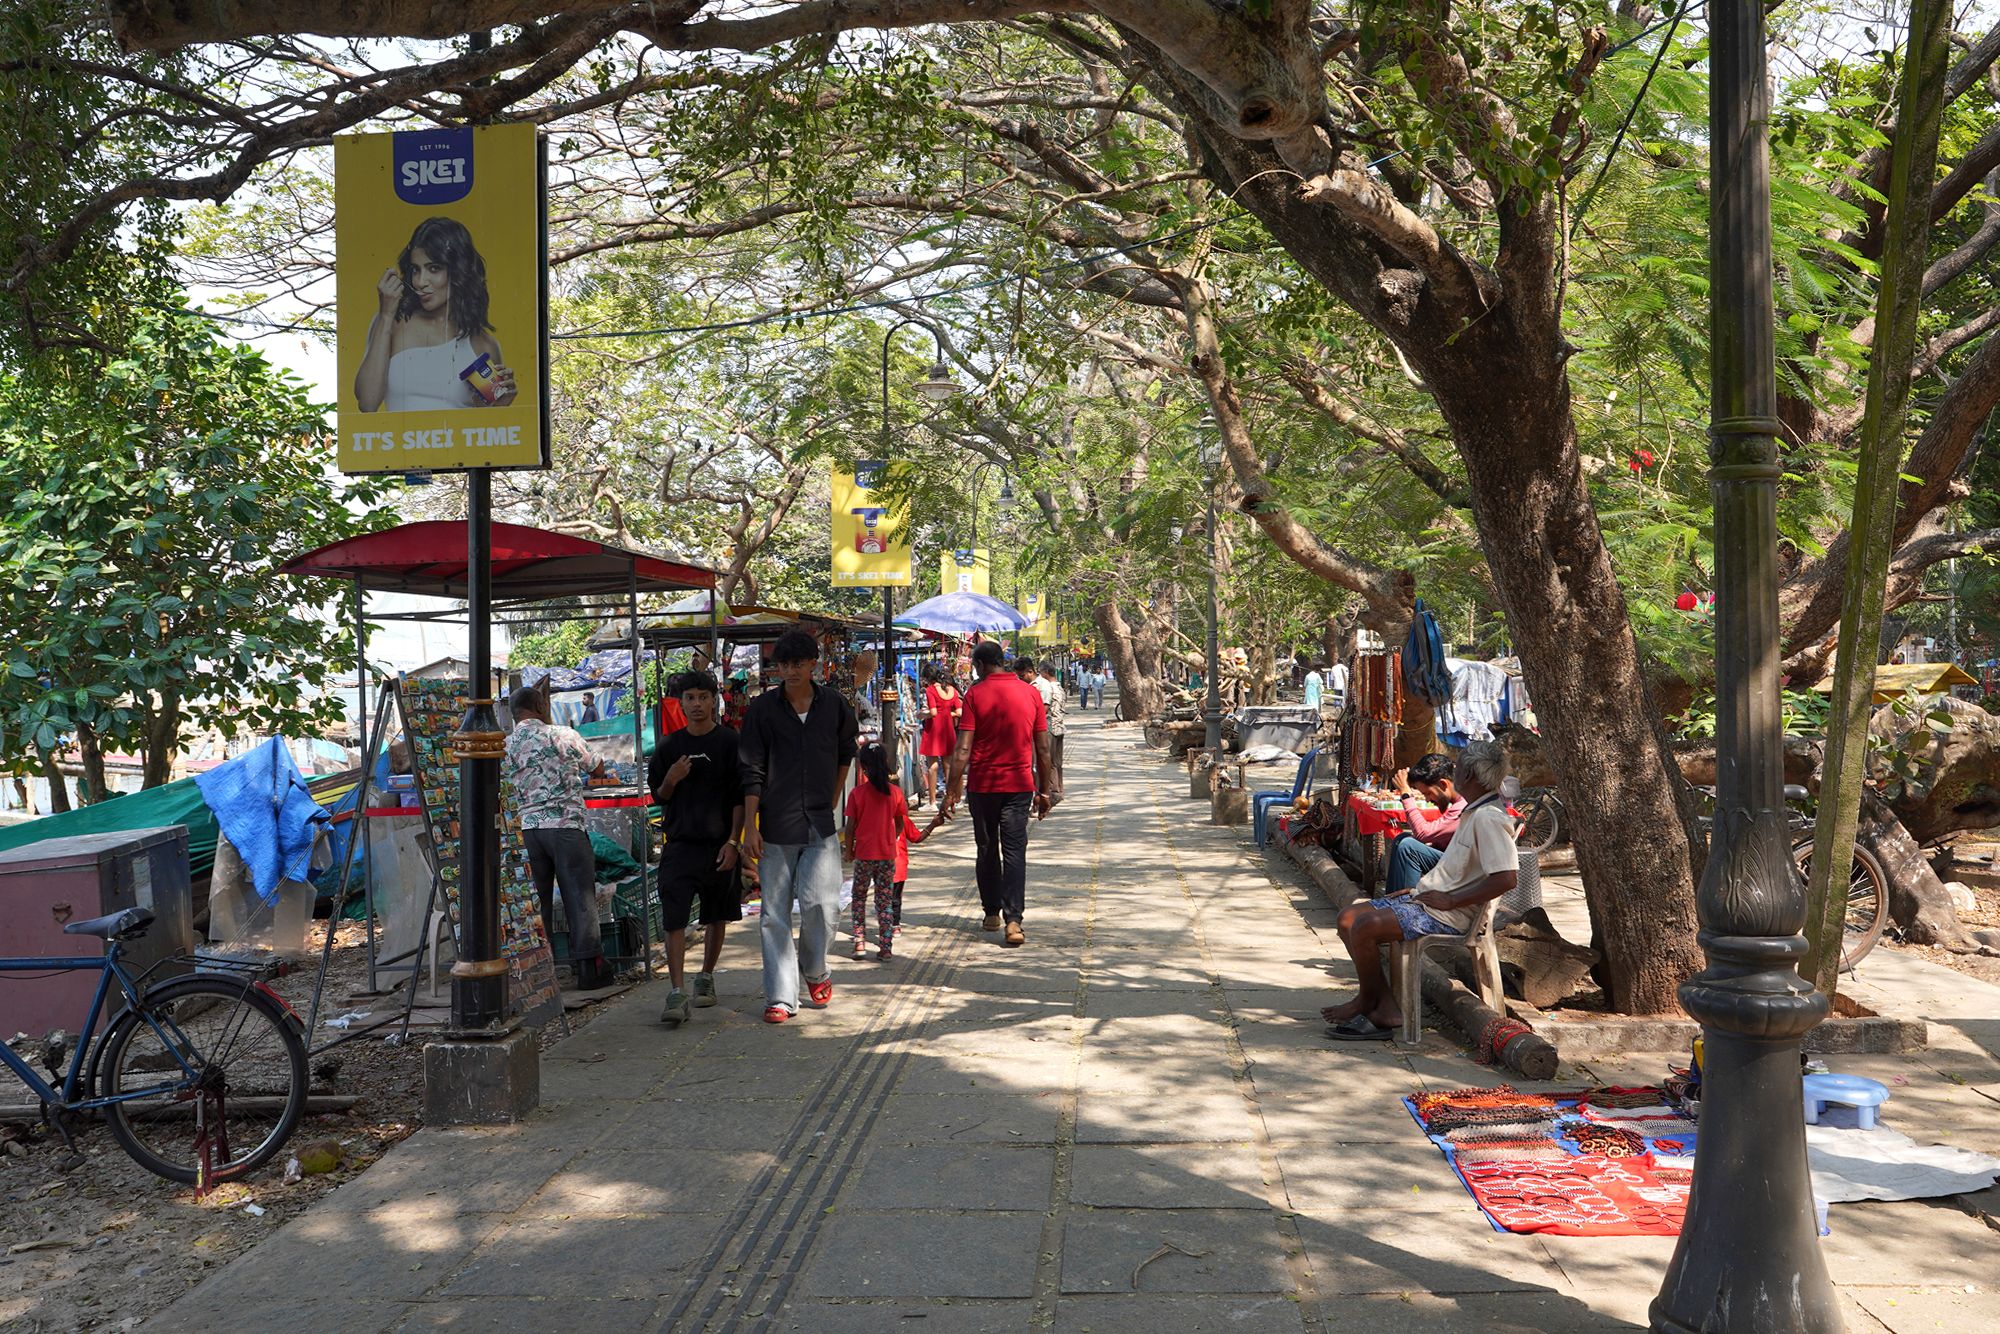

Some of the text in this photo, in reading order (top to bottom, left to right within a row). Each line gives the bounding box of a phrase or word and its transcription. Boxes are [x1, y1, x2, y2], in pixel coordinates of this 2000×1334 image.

[402, 158, 466, 186] SKEI
[352, 426, 521, 451] IT'S SKEI TIME
[838, 572, 855, 580] IT'S
